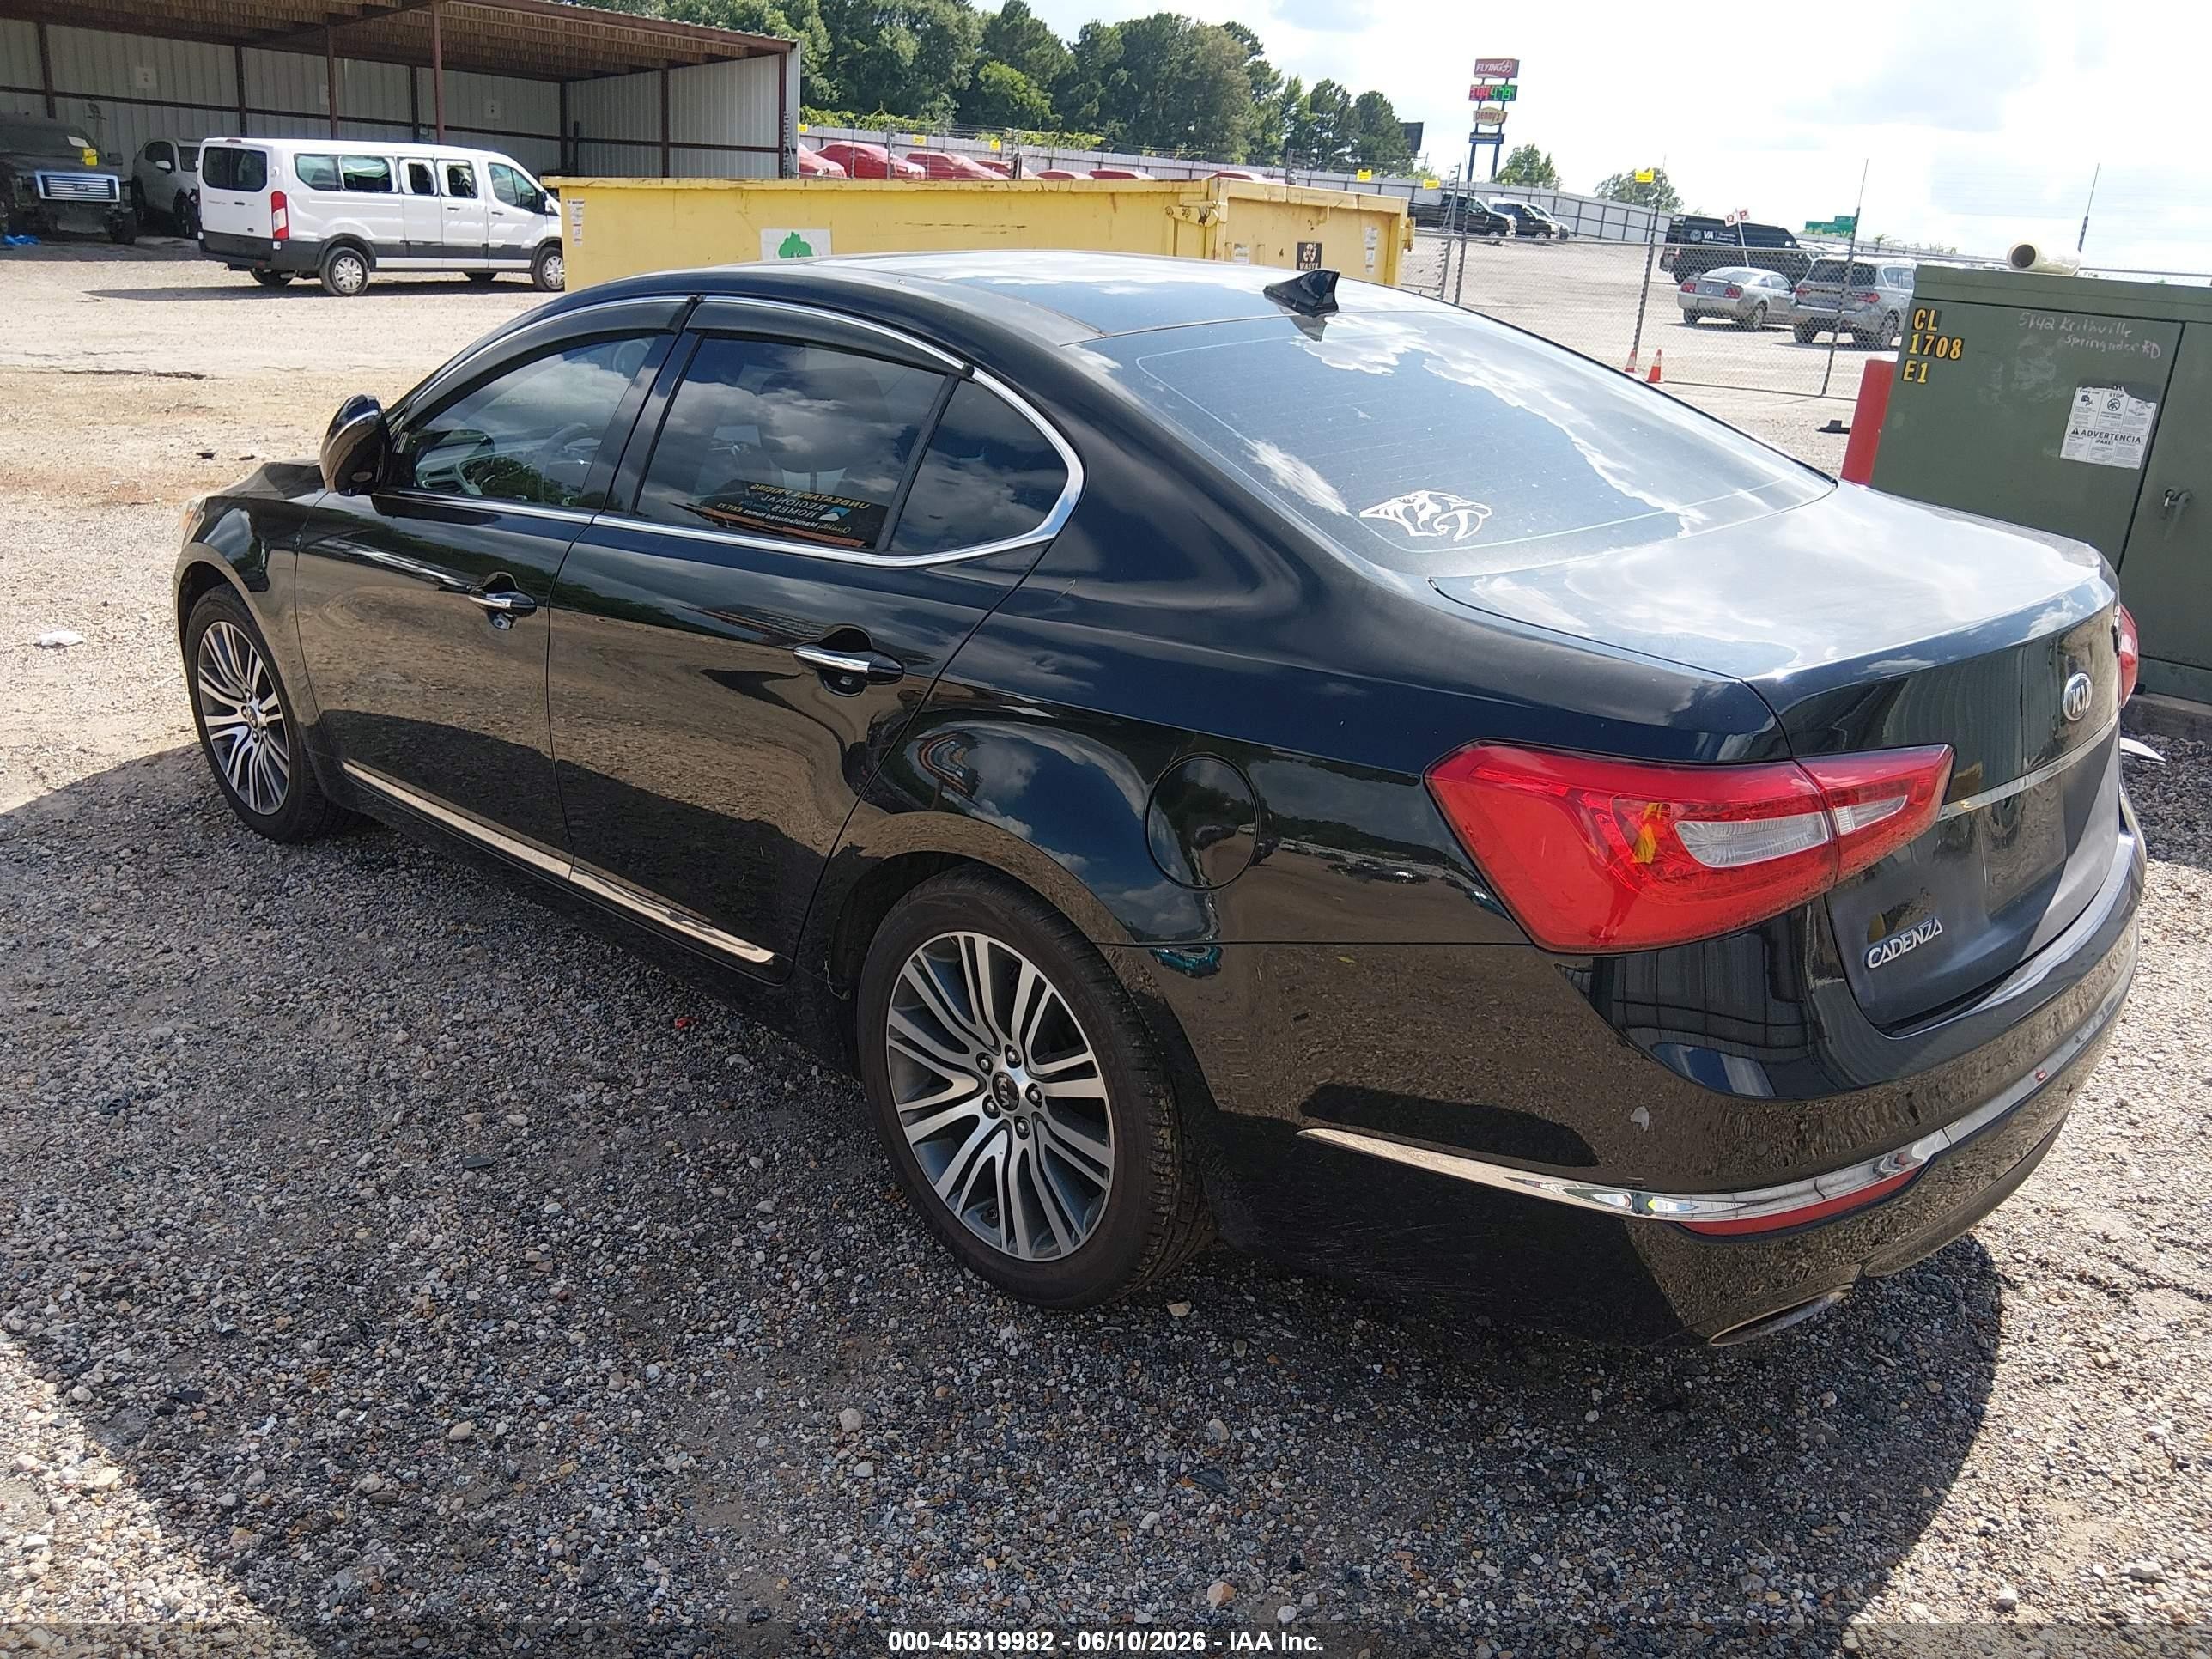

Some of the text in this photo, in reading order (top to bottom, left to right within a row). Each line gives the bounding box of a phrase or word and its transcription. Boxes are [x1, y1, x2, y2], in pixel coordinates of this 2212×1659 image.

[1727, 215, 1735, 223] Q
[1704, 231, 1714, 240] VA
[1914, 309, 1938, 331] CL
[1909, 333, 1963, 360] 1708
[1903, 360, 1929, 384] E1
[2081, 428, 2141, 444] ADVERTENCIA
[1867, 916, 1943, 969] CADENZA
